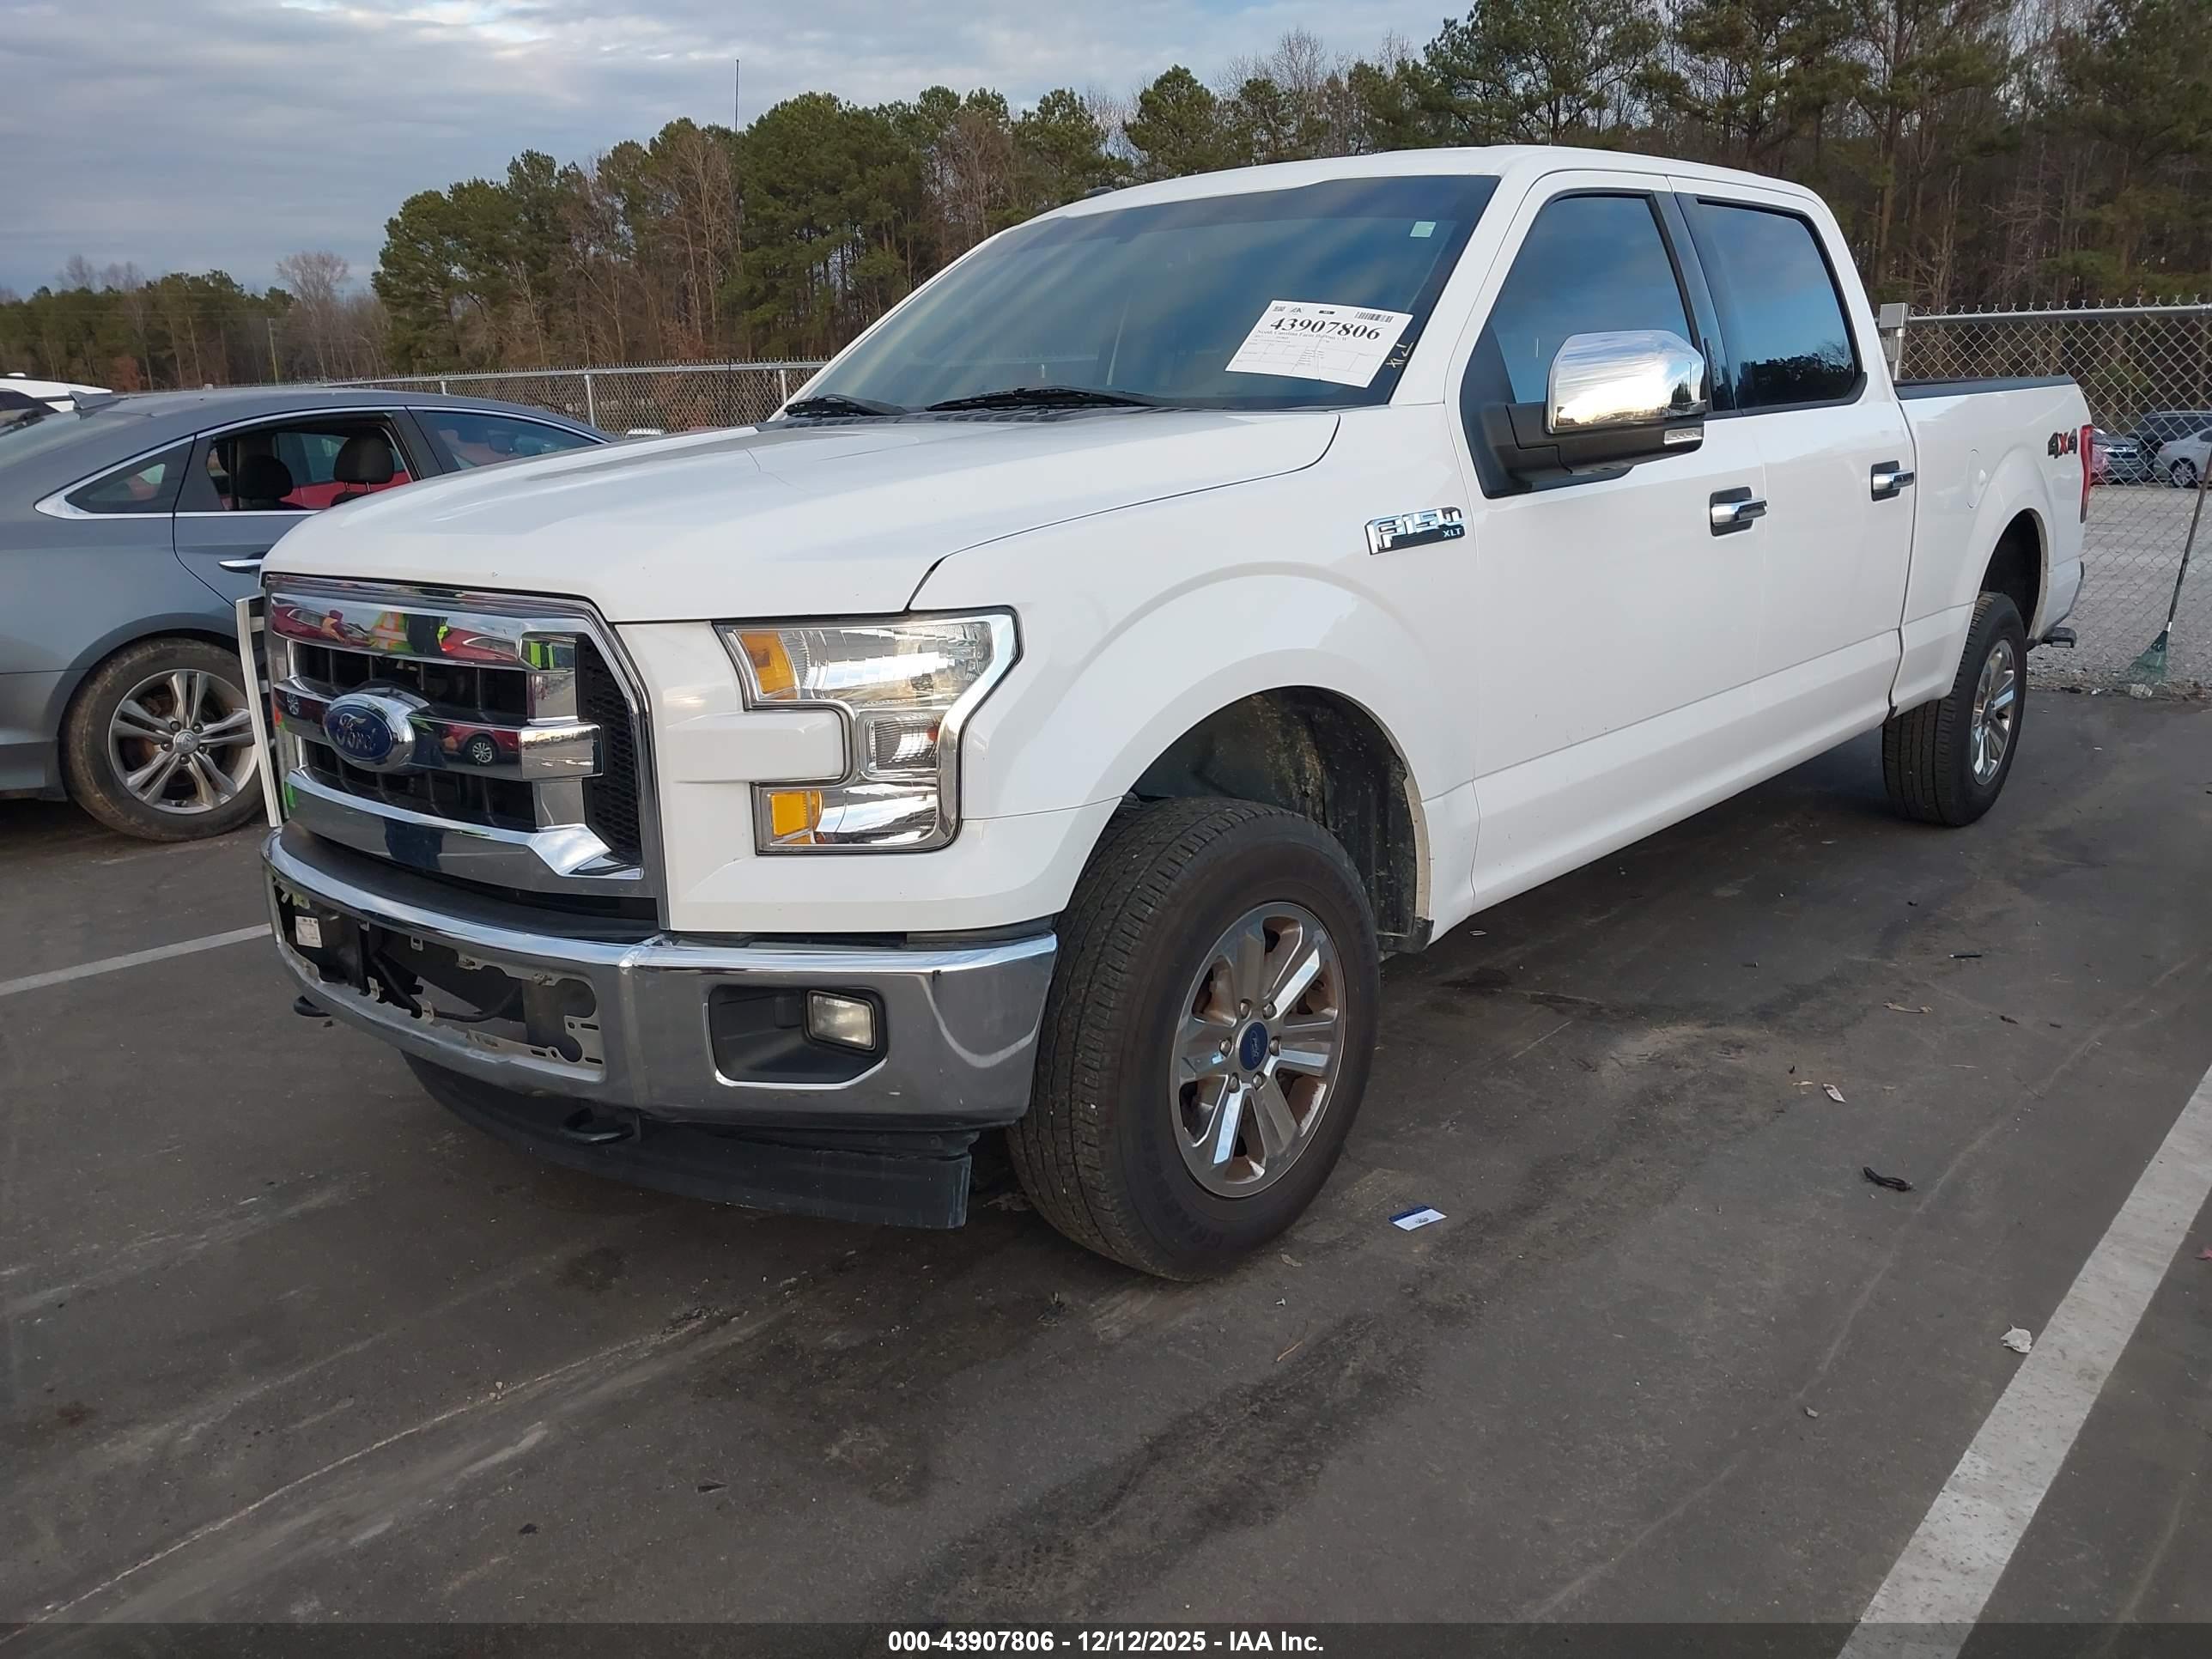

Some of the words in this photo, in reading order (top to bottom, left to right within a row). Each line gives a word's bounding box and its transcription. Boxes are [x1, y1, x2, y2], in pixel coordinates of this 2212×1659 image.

[1269, 317, 1385, 340] 43907806
[1443, 527, 1462, 538] XLT
[335, 713, 379, 751] Ford
